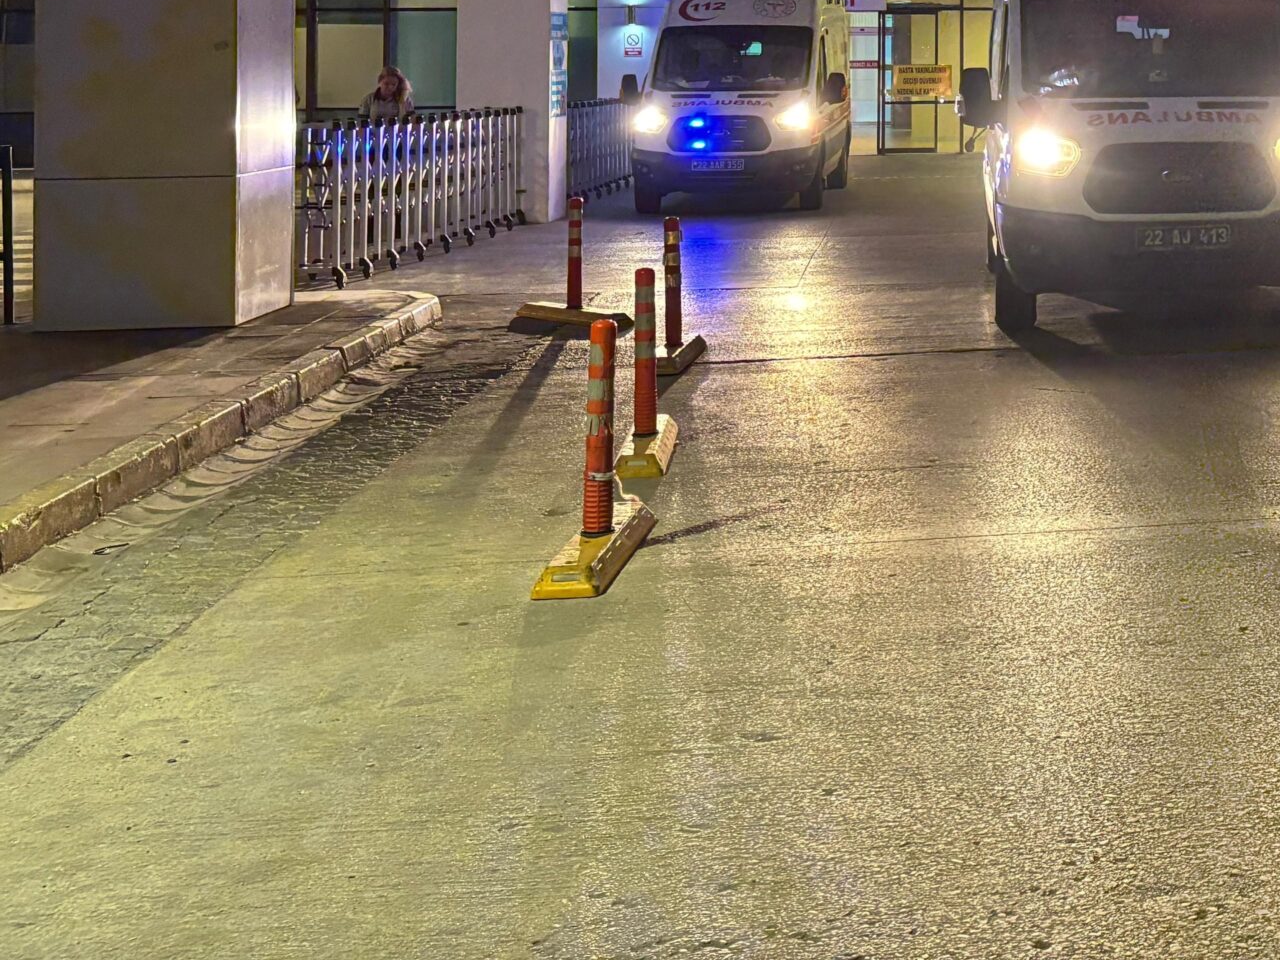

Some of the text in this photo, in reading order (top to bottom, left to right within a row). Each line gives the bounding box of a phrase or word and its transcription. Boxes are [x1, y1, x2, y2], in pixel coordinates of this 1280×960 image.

[690, 1, 726, 12] 112
[1144, 230, 1163, 246] 22
[1199, 227, 1228, 244] 413
